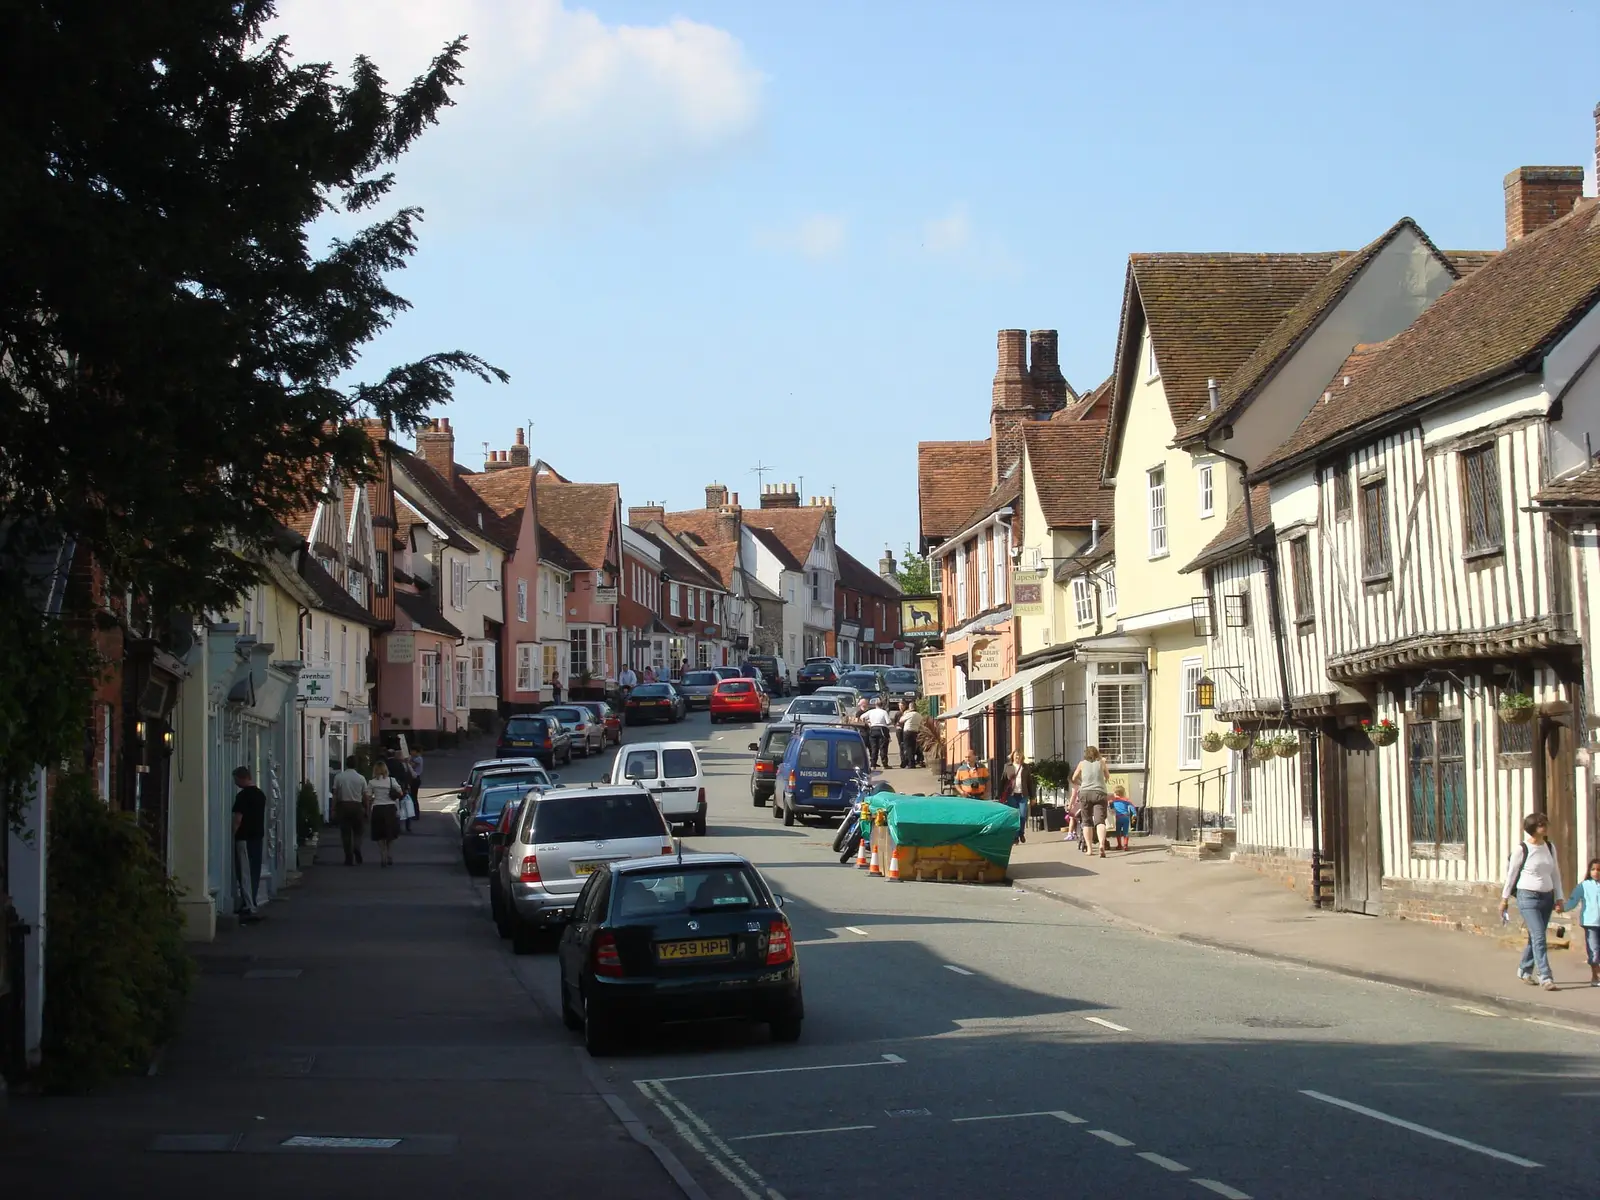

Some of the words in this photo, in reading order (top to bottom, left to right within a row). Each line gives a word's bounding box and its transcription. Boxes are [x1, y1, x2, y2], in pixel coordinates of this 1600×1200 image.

[800, 770, 828, 778] NISSAN
[660, 943, 698, 957] Y759
[700, 940, 729, 954] HPH
